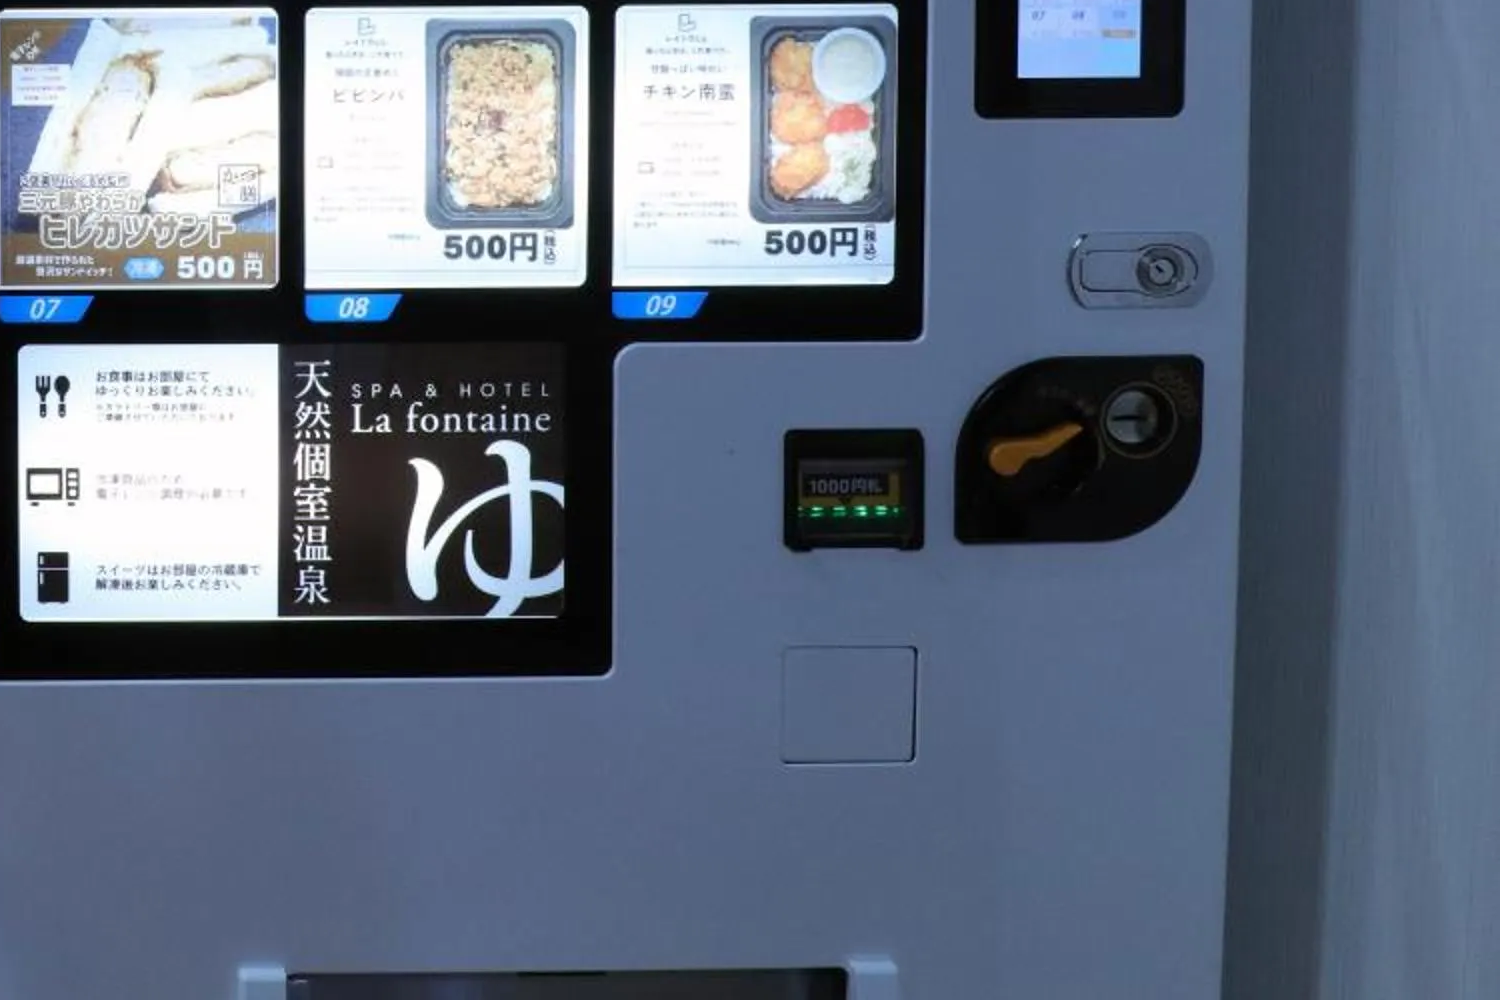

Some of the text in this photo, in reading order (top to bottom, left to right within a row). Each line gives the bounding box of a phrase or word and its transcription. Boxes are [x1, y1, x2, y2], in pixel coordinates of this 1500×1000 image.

[39, 213, 237, 249] ヒレカツサンド
[764, 227, 859, 257] 500円
[443, 232, 539, 262] 500円
[177, 256, 263, 280] 500円
[29, 298, 62, 320] 07
[338, 296, 370, 319] 08
[645, 294, 677, 317] 09
[351, 382, 550, 398] SPA & HOTEL
[351, 401, 552, 433] La fontaine
[293, 359, 332, 605] 天然個室温泉
[406, 439, 565, 618] ゆ
